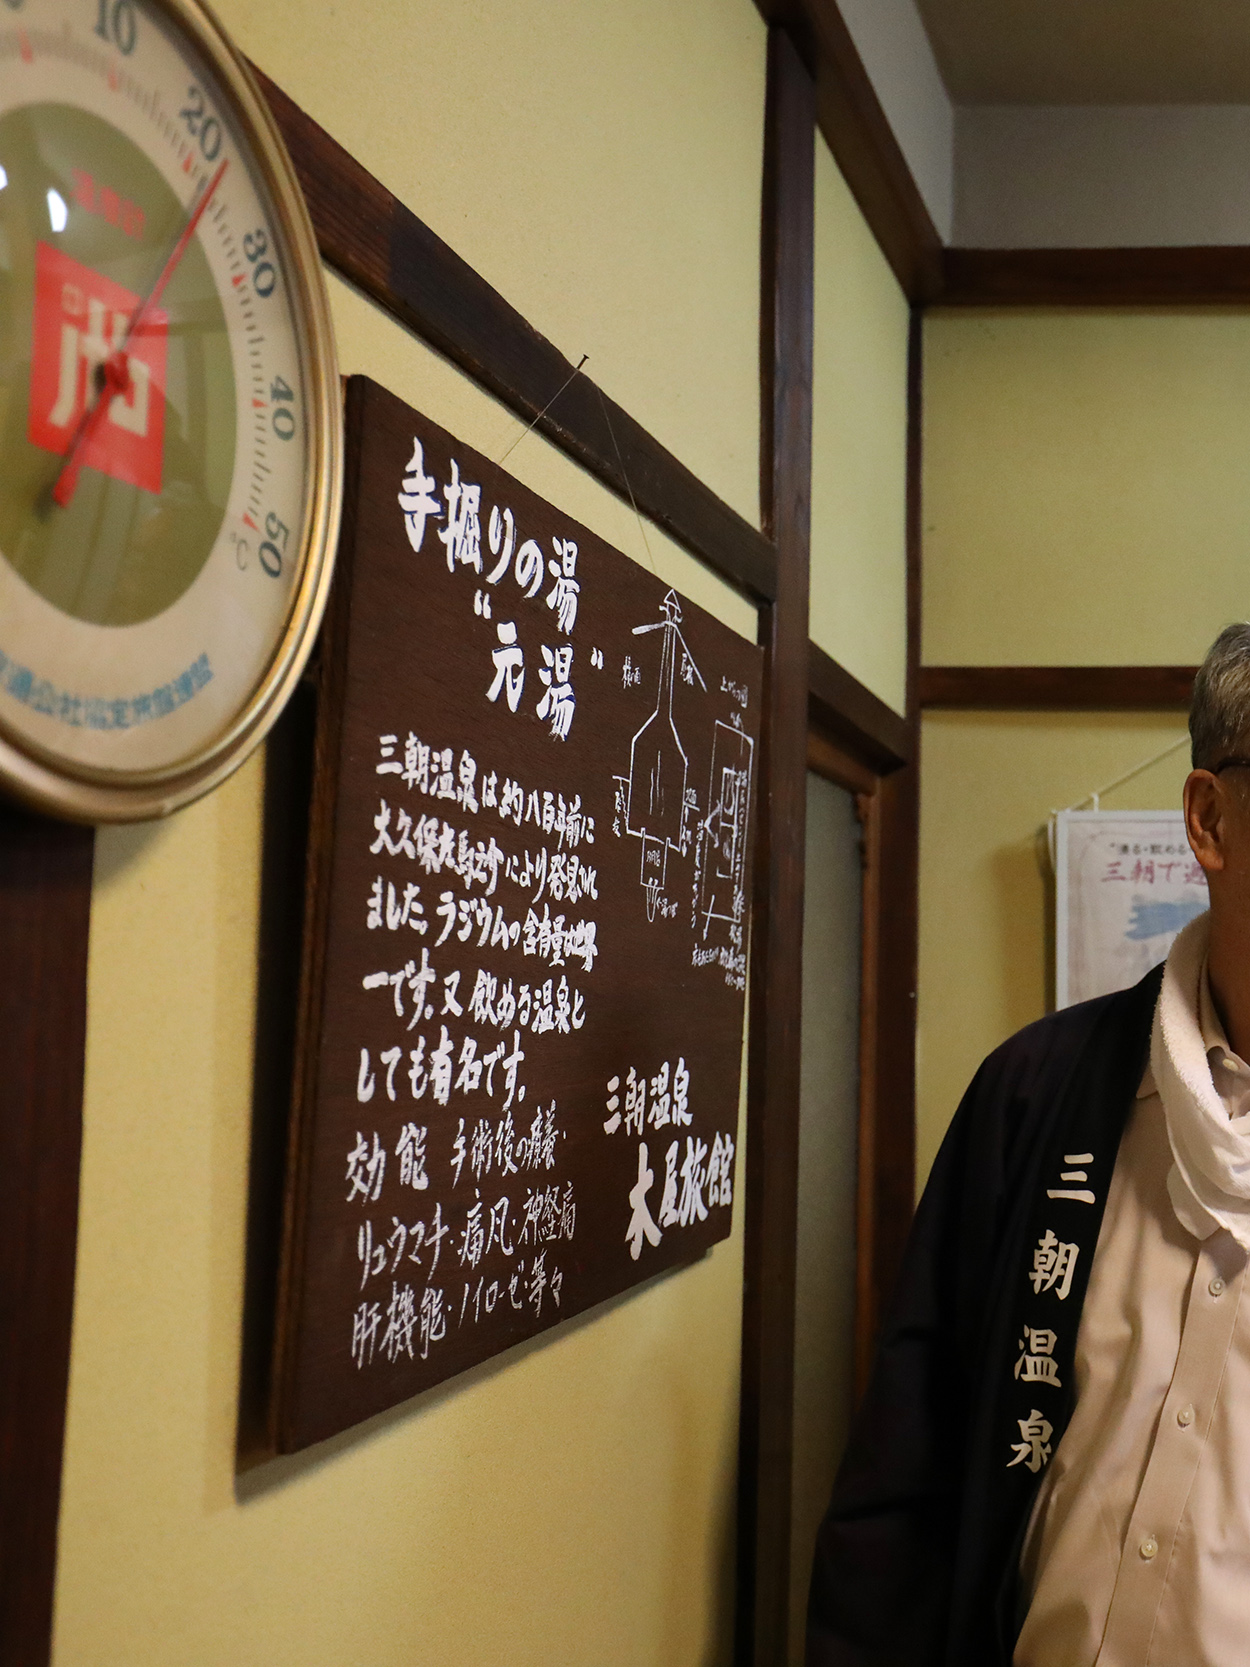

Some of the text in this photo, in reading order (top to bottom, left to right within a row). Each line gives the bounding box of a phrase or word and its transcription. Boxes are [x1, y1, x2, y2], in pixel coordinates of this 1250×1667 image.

[180, 86, 223, 162] 20
[243, 228, 276, 298] 30
[270, 375, 295, 441] 40
[259, 511, 290, 578] 50
[398, 436, 580, 635] 手掘りの湯
[603, 1057, 693, 1136] 三朝温泉
[625, 1131, 734, 1261] 木屋旅館
[1006, 1152, 1096, 1473] 三朝温泉
